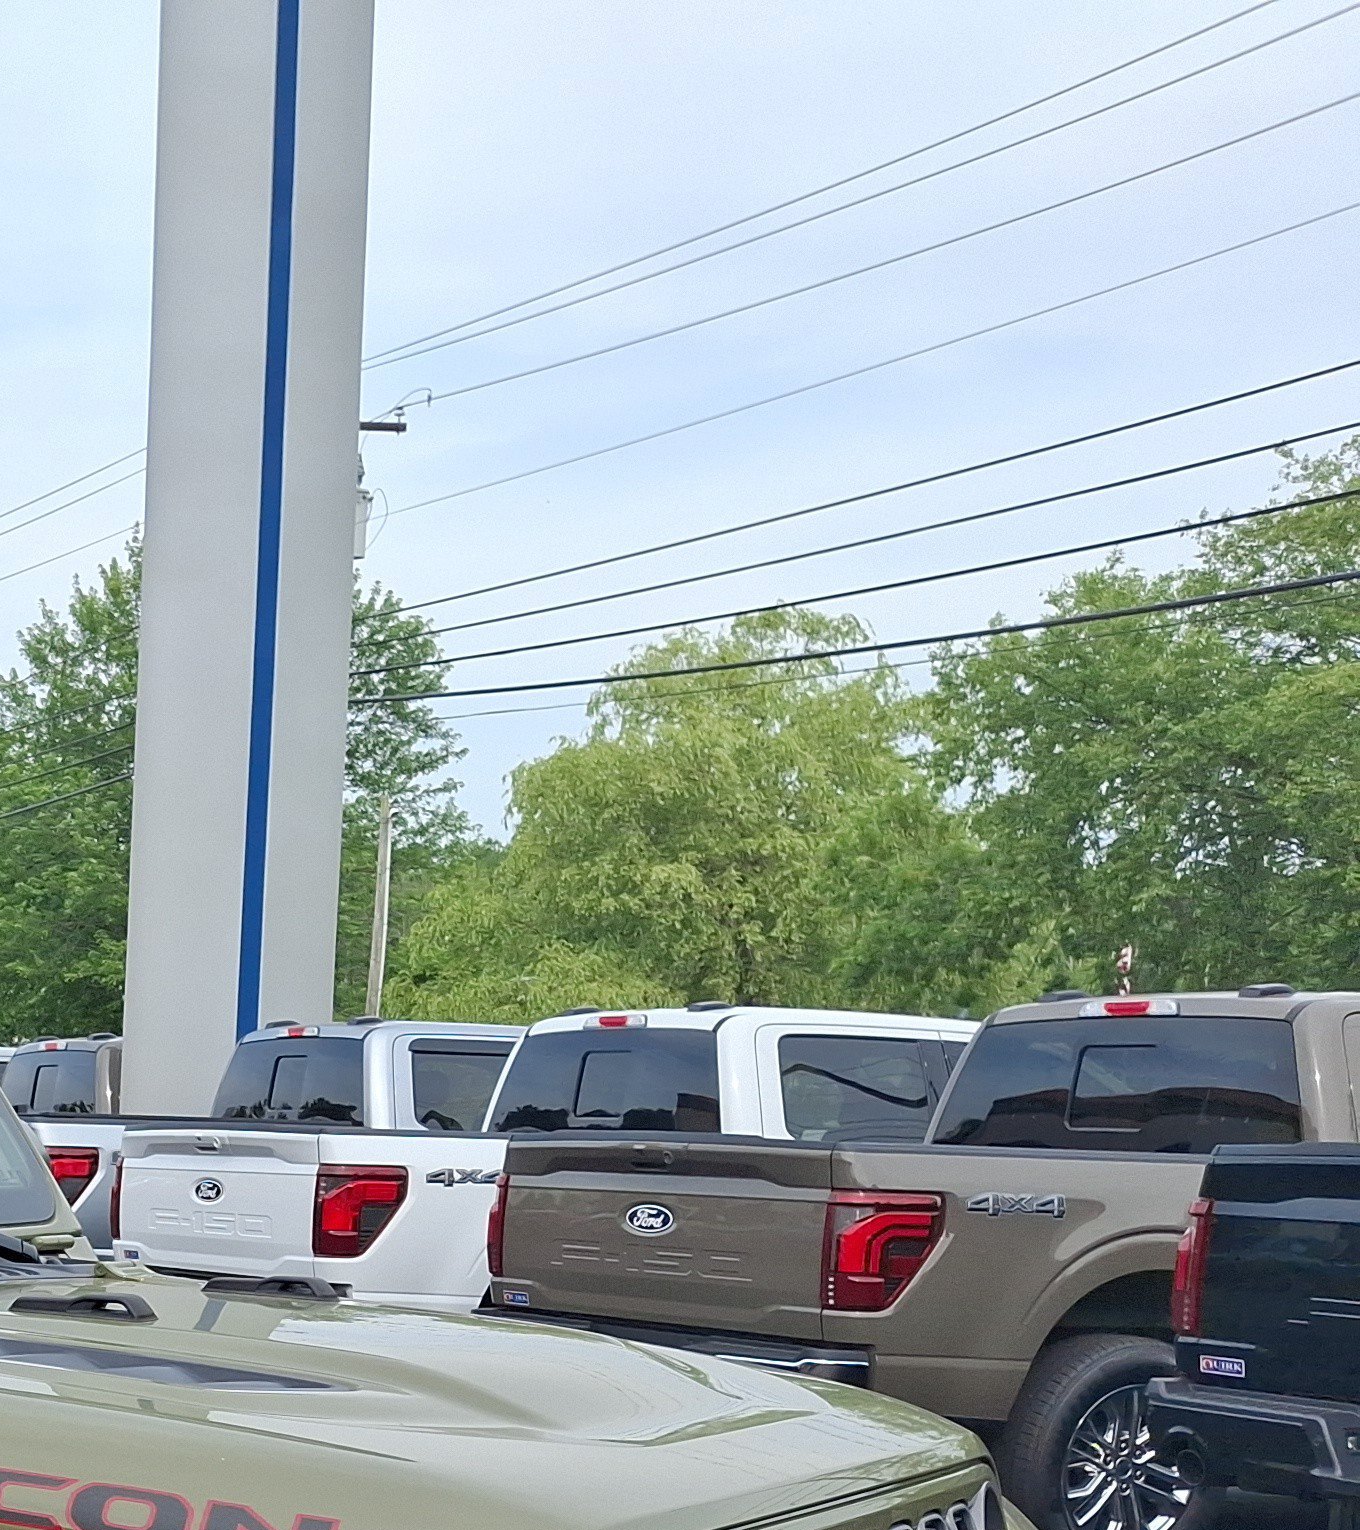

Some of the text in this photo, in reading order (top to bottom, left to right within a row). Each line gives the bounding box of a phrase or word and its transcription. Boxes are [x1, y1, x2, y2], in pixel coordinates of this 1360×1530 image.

[148, 1208, 273, 1239] F-150
[633, 1208, 664, 1228] Ford
[550, 1237, 753, 1282] F-150
[1203, 1358, 1242, 1372] QUIRK
